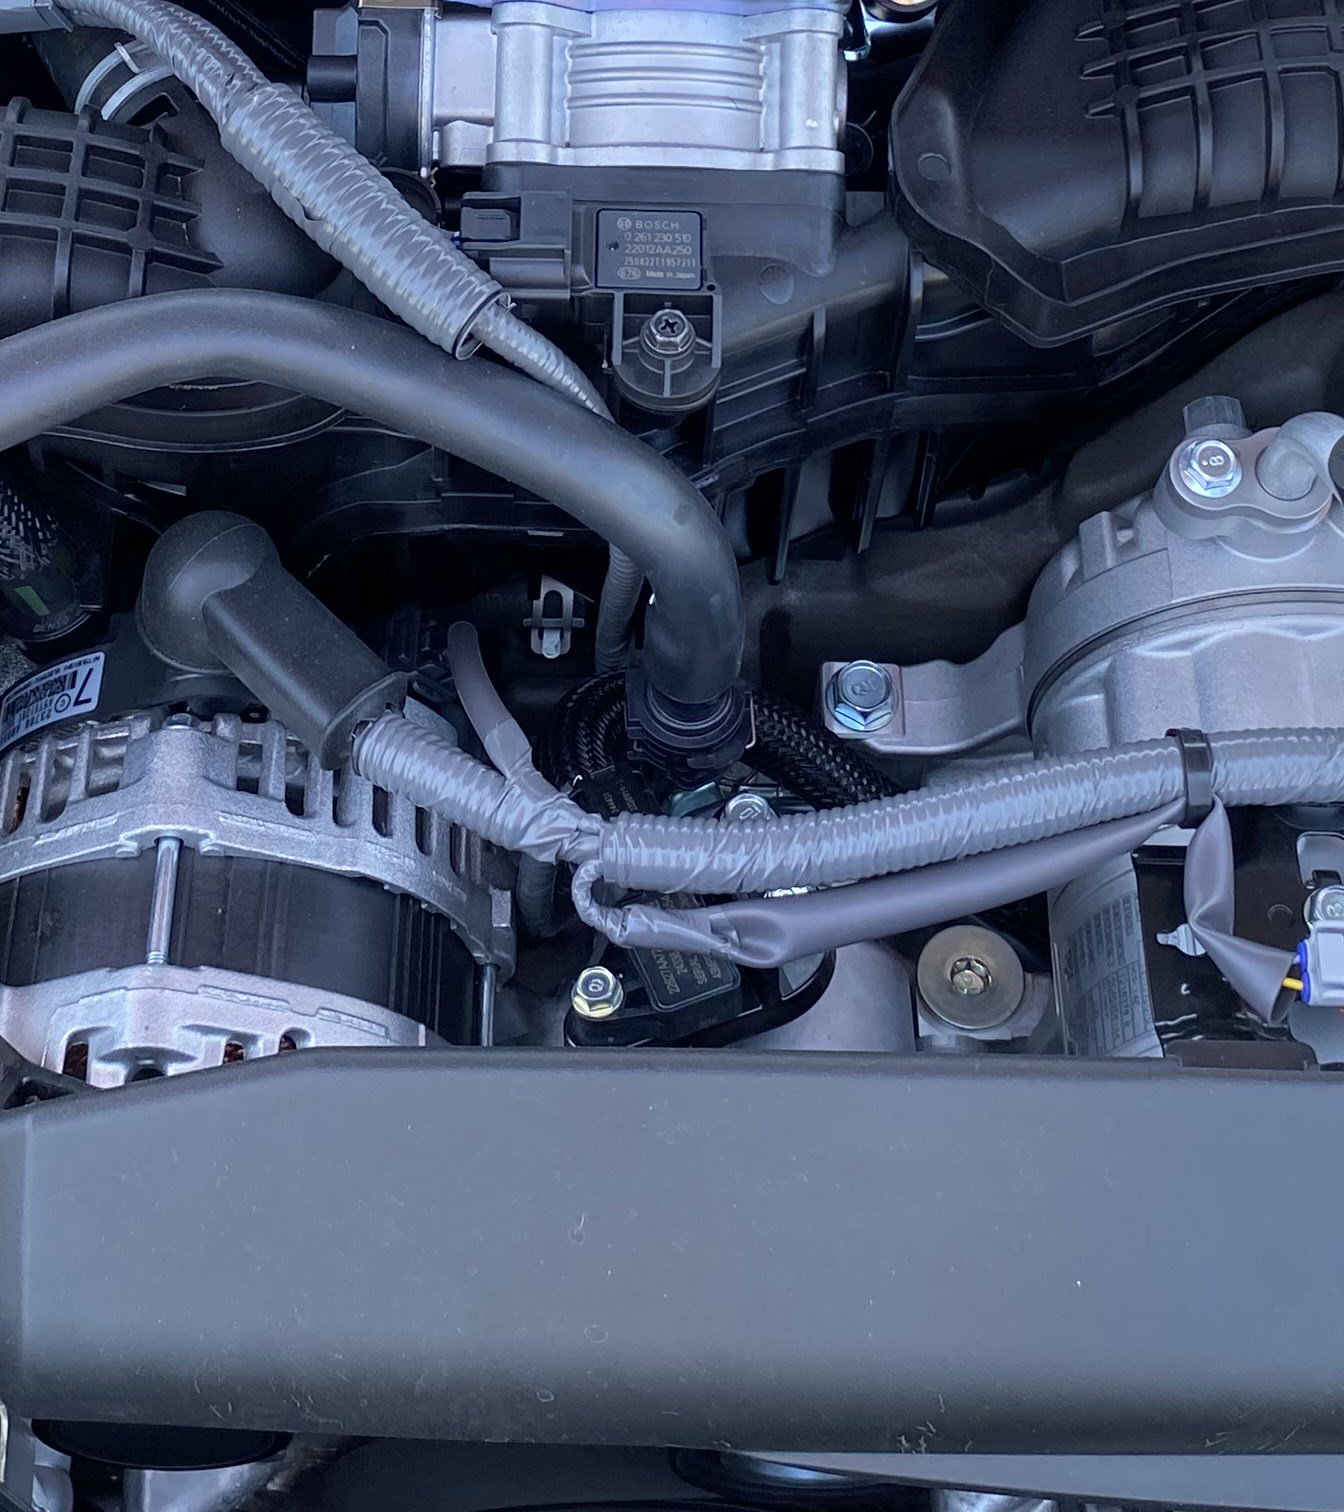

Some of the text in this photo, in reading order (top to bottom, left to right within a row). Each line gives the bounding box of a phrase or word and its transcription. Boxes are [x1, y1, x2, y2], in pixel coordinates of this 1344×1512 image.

[635, 220, 680, 230] BOSCH
[634, 232, 652, 242] 261
[654, 233, 672, 243] 230
[675, 233, 692, 243] 510
[73, 668, 94, 707] 7
